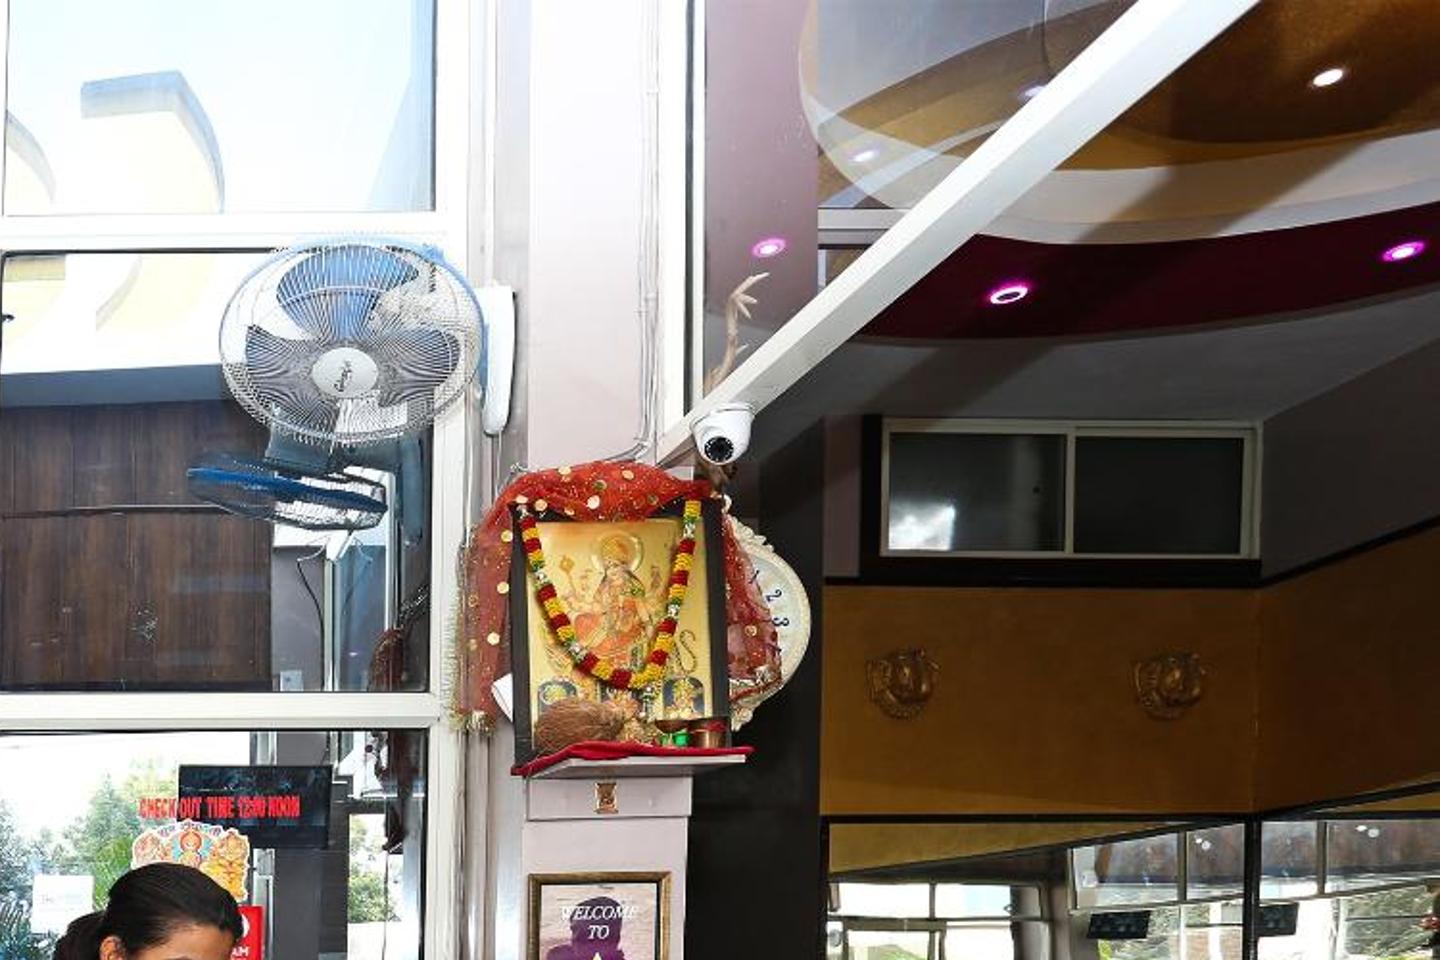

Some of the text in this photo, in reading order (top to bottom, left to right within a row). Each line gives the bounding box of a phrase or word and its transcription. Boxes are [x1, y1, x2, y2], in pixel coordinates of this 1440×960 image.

[766, 588, 782, 602] 2
[772, 617, 790, 627] 3
[139, 797, 177, 819] CHECK
[179, 797, 201, 819] OUT
[205, 796, 235, 819] TIME
[267, 795, 300, 818] NOON
[559, 905, 639, 920] WELCOME
[587, 924, 610, 940] TO
